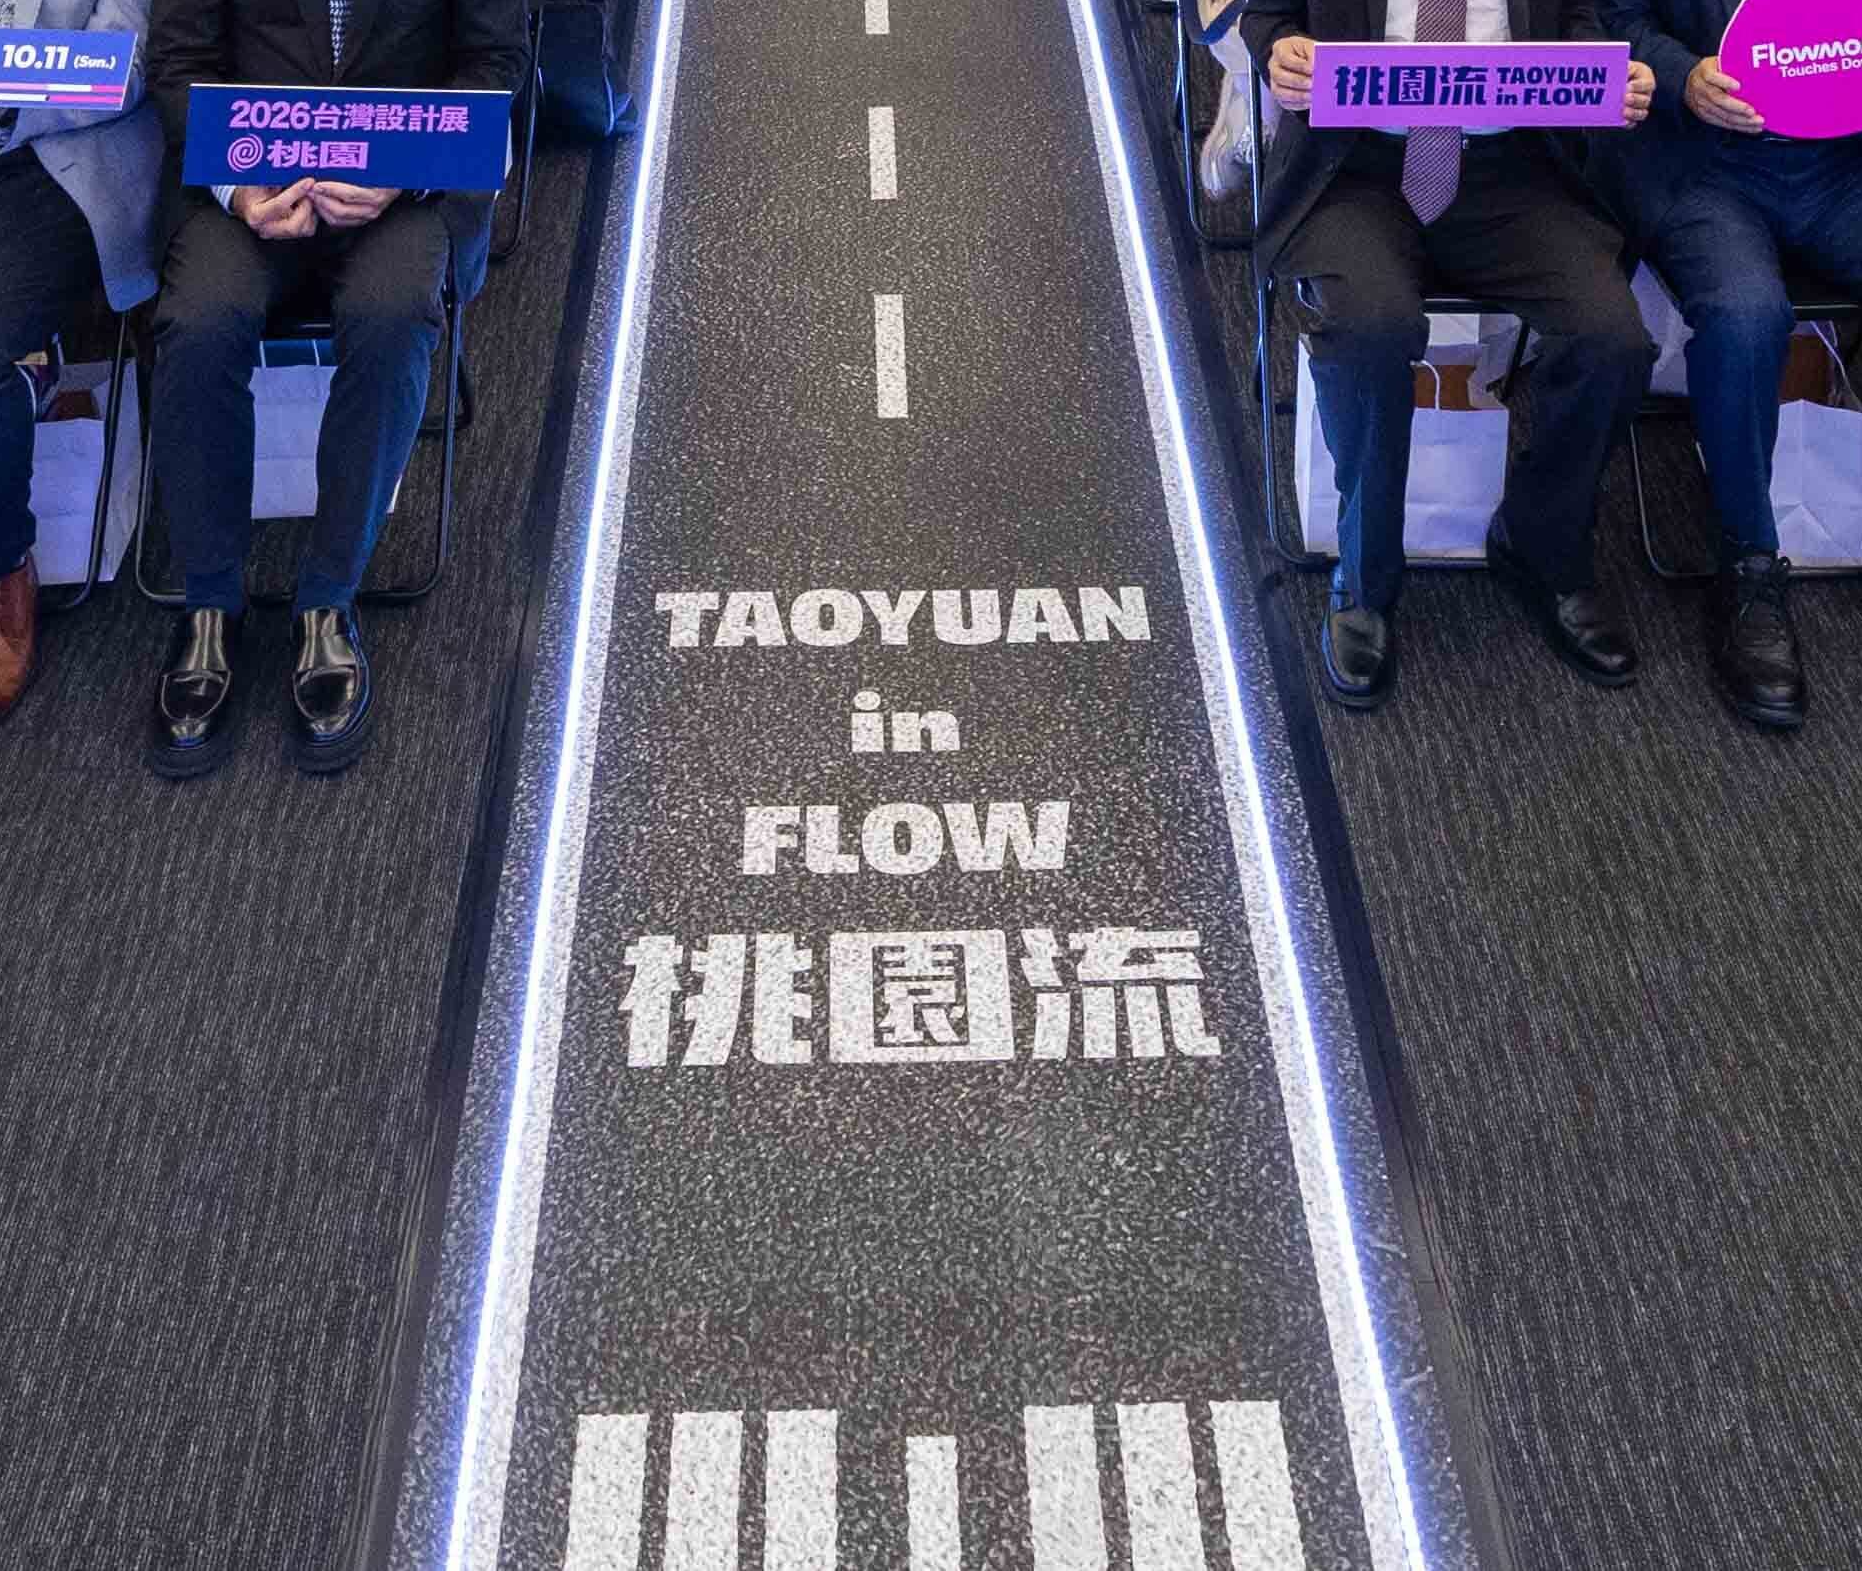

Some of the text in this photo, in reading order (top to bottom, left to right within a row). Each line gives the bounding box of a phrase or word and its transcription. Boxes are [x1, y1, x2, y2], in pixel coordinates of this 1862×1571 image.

[1, 43, 69, 70] 10.11
[73, 54, 117, 71] (Sun.)
[1496, 66, 1607, 84] TAOYUAN
[1779, 61, 1838, 78] Touches
[1334, 65, 1488, 106] 桃園流
[1496, 87, 1605, 106] in FLOW
[228, 99, 470, 133] 2026台灣設計展
[655, 586, 1152, 648] TAOYUAN
[849, 690, 961, 754] in
[741, 801, 1072, 876] FLOW
[618, 926, 1222, 1069] 桃園流
